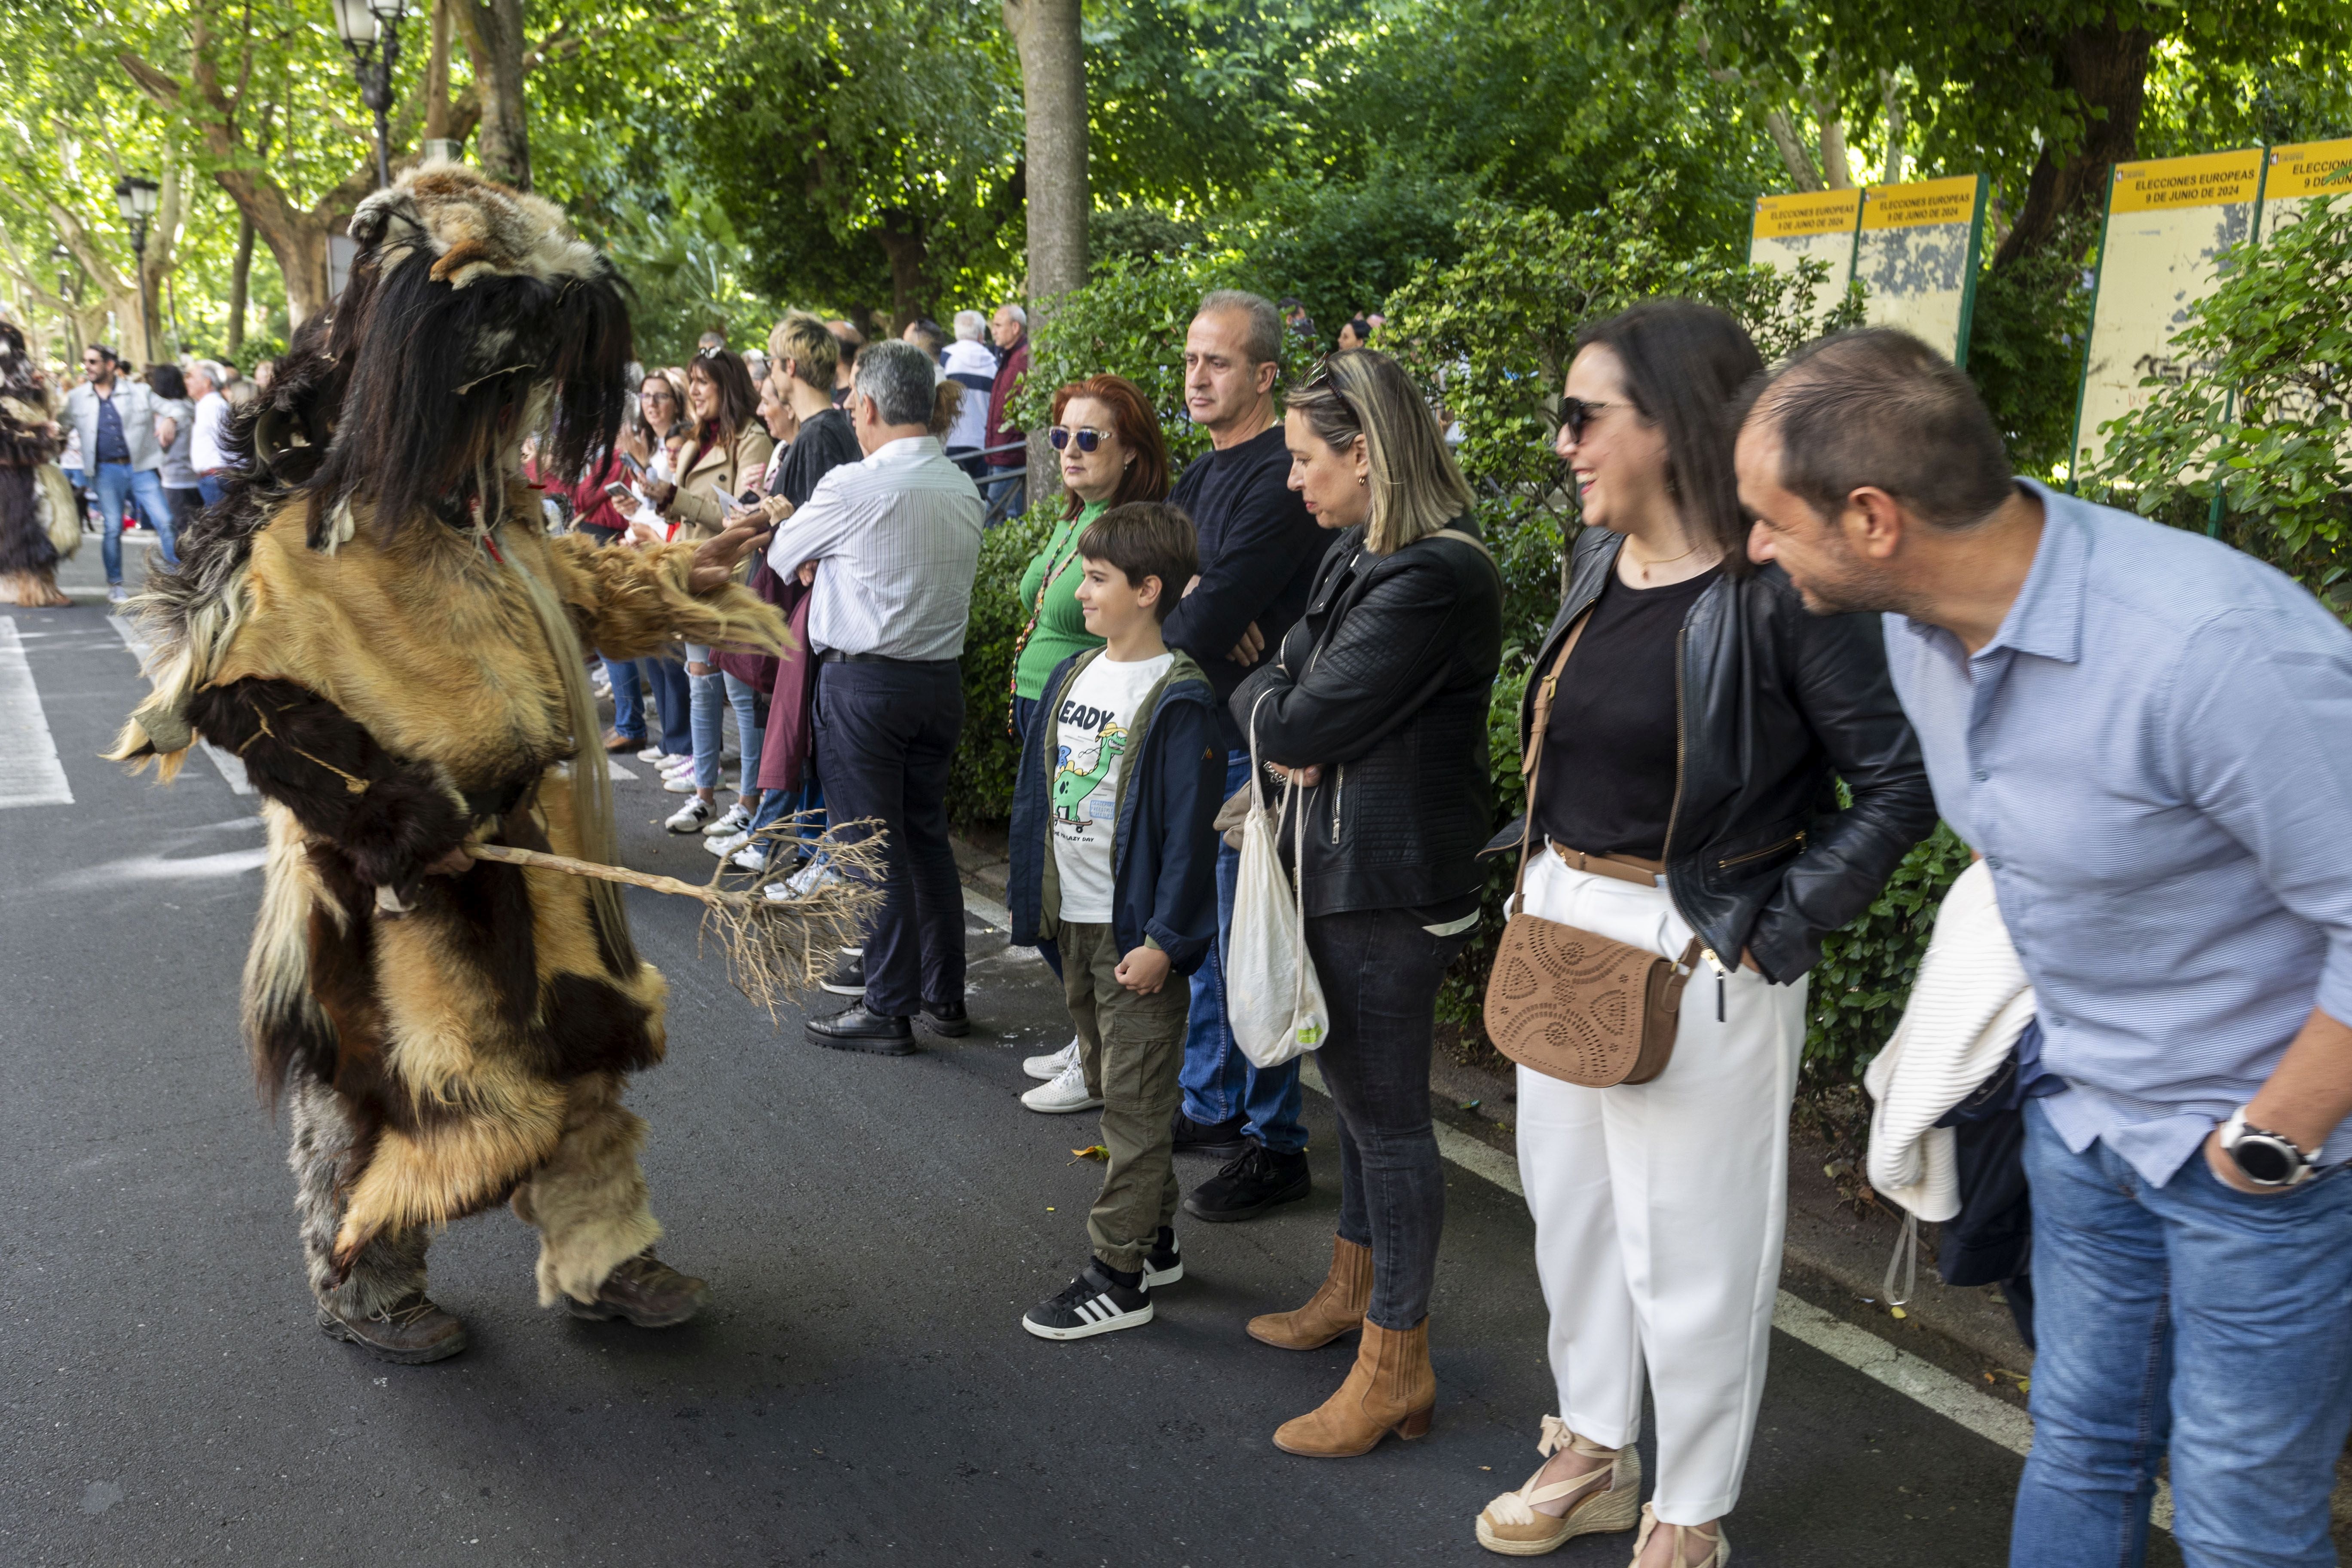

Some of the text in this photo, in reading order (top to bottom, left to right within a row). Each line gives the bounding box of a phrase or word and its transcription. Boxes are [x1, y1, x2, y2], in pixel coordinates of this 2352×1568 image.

[2135, 169, 2254, 190] ELECCIONES EUROPEAS
[2304, 178, 2310, 188] 9
[1880, 193, 1969, 211] ELECCIONES EUROPEAS
[2146, 185, 2239, 203] 9 DE JUNIO DE 2024
[1770, 204, 1854, 220] ELECCIONES EUROPEAS
[1893, 212, 1903, 220] DE
[1905, 210, 1927, 220] JUNIO
[1929, 208, 1939, 218] DE
[1942, 207, 1958, 217] 2024
[1783, 221, 1792, 230] DE
[1794, 219, 1815, 229] JUNIO
[1816, 218, 1825, 227] DE
[1828, 217, 1843, 226] 2024
